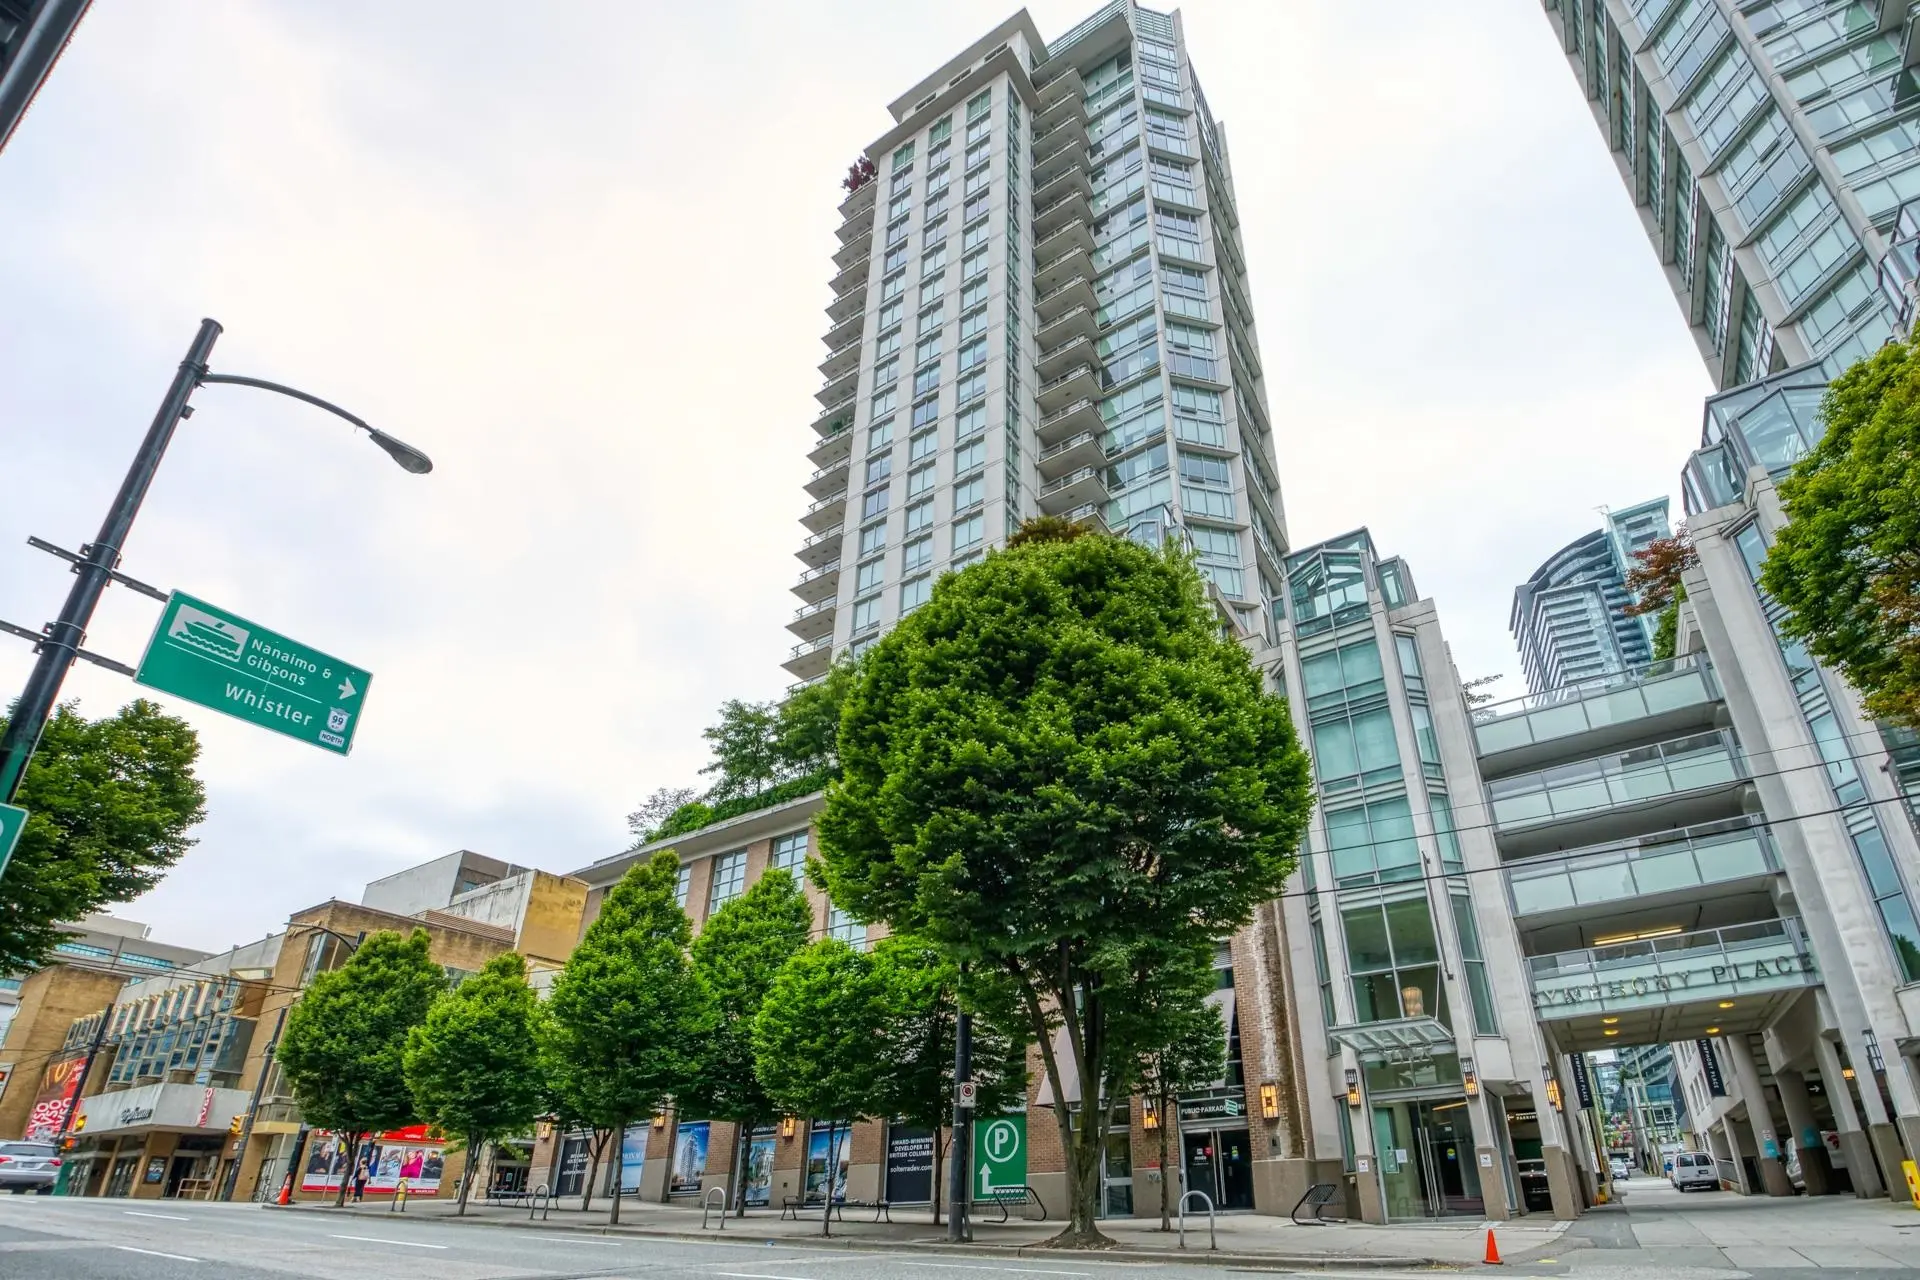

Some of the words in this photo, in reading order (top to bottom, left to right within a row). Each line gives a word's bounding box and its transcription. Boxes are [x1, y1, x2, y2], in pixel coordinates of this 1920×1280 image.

[247, 655, 306, 686] Gibsons
[251, 639, 317, 673] Nanaimo
[322, 668, 332, 679] &
[225, 683, 313, 726] Whistler
[332, 715, 344, 726] 99
[321, 733, 343, 745] NORTH
[1711, 951, 1816, 984] PLACE
[1709, 1071, 1720, 1089] PLACE
[889, 1151, 908, 1159] BRITISH
[994, 1127, 1010, 1155] P
